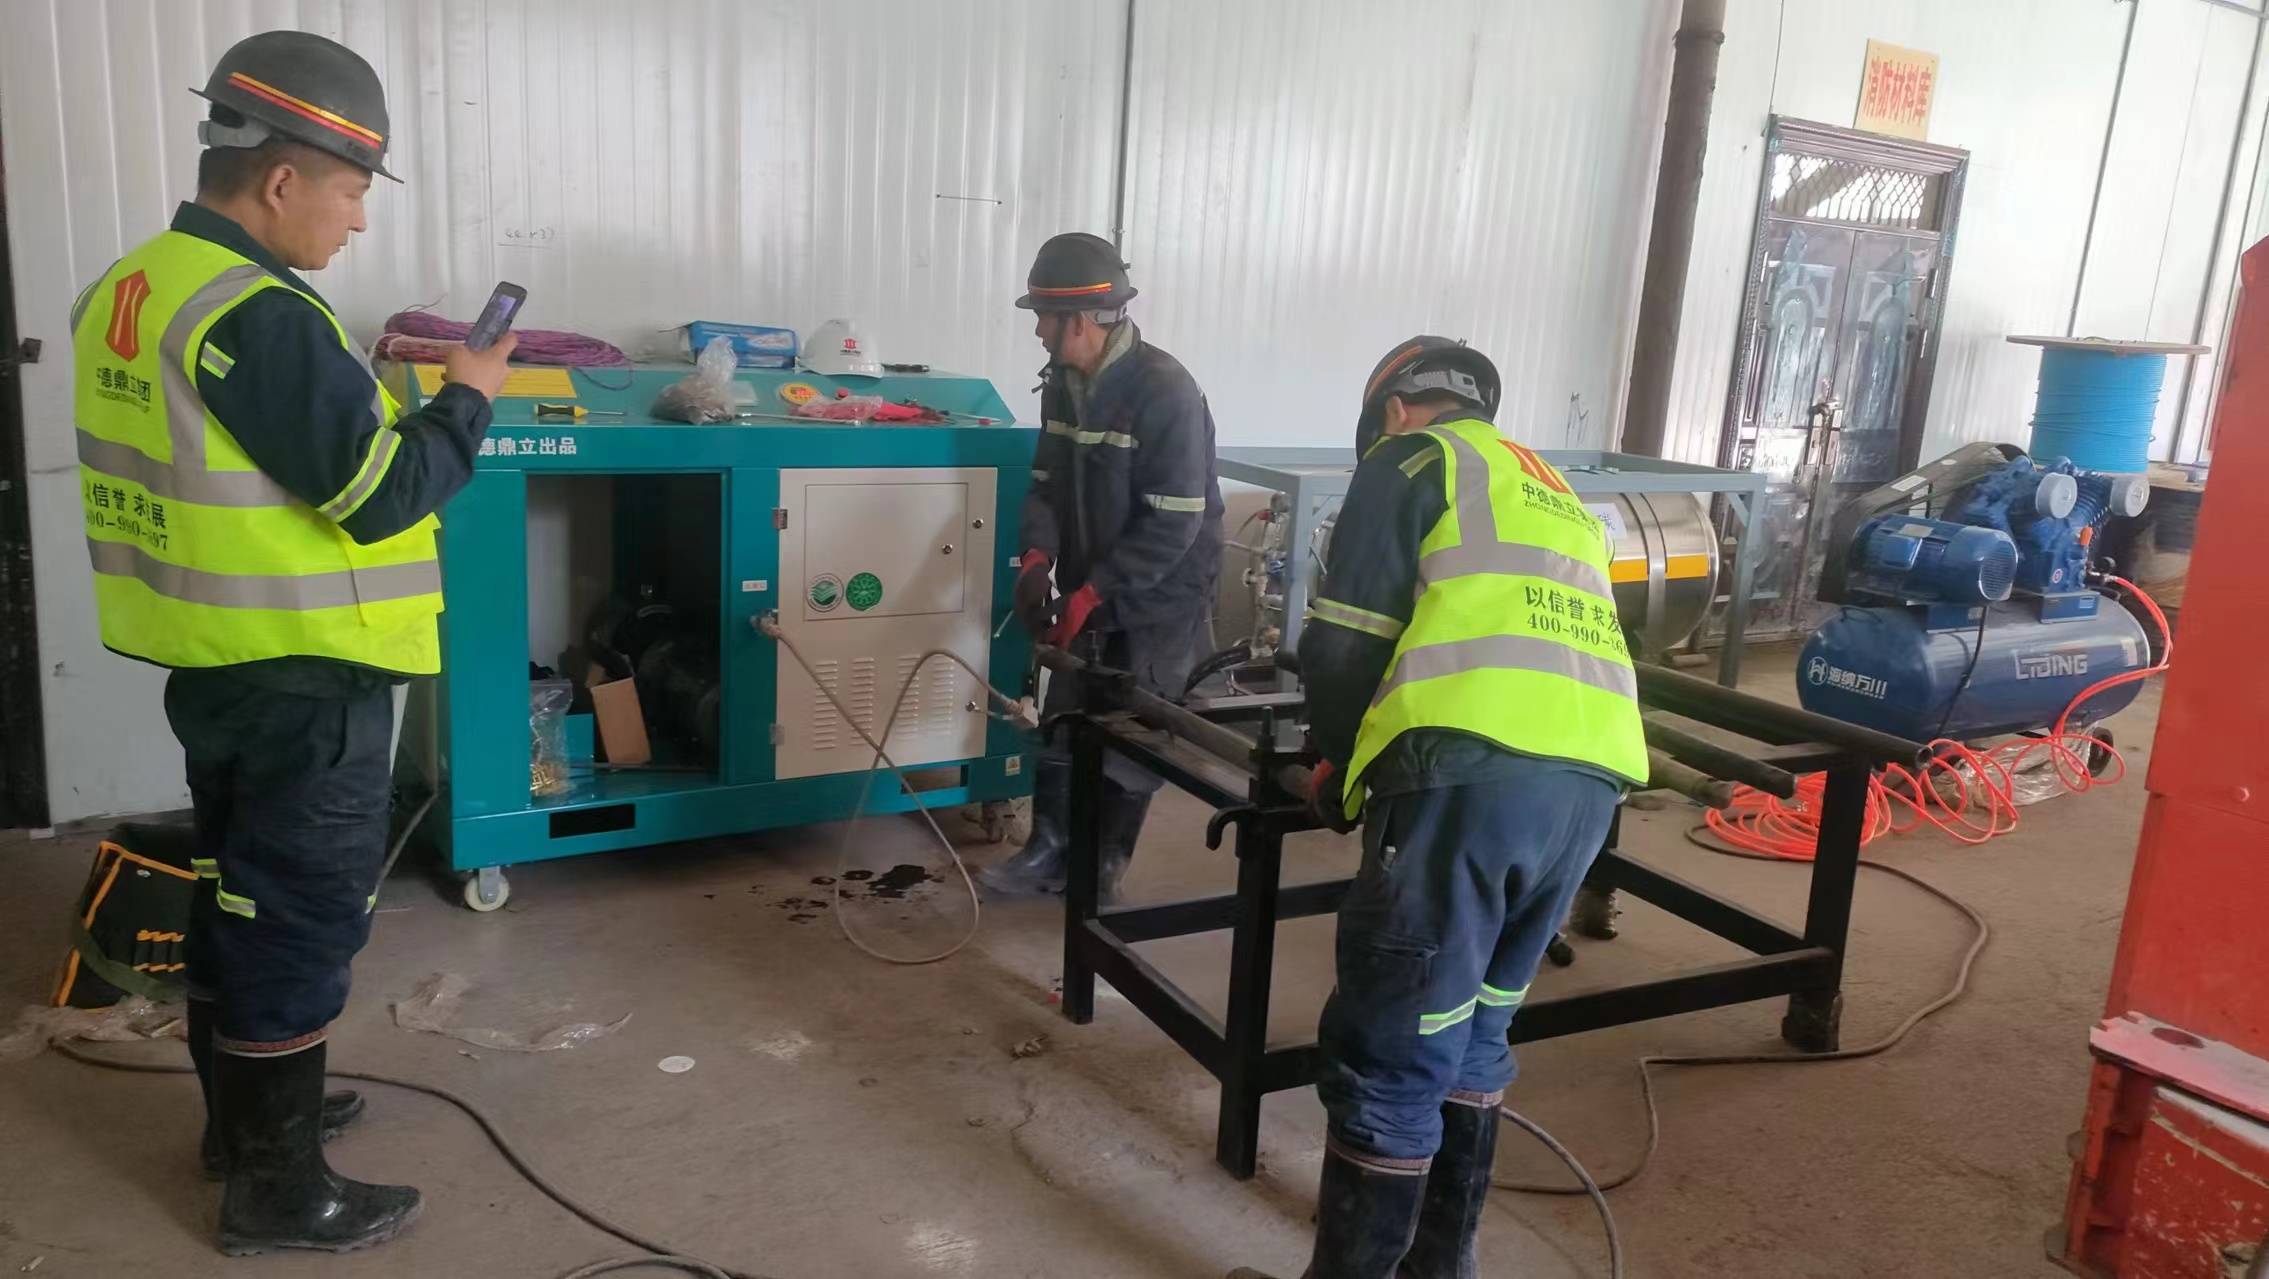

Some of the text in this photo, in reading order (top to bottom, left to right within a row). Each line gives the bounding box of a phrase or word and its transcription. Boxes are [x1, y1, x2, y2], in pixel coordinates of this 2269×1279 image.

[1863, 57, 1931, 125] 消防材料库
[96, 367, 152, 402] 德鼎立团
[85, 479, 166, 529] 信誉求展
